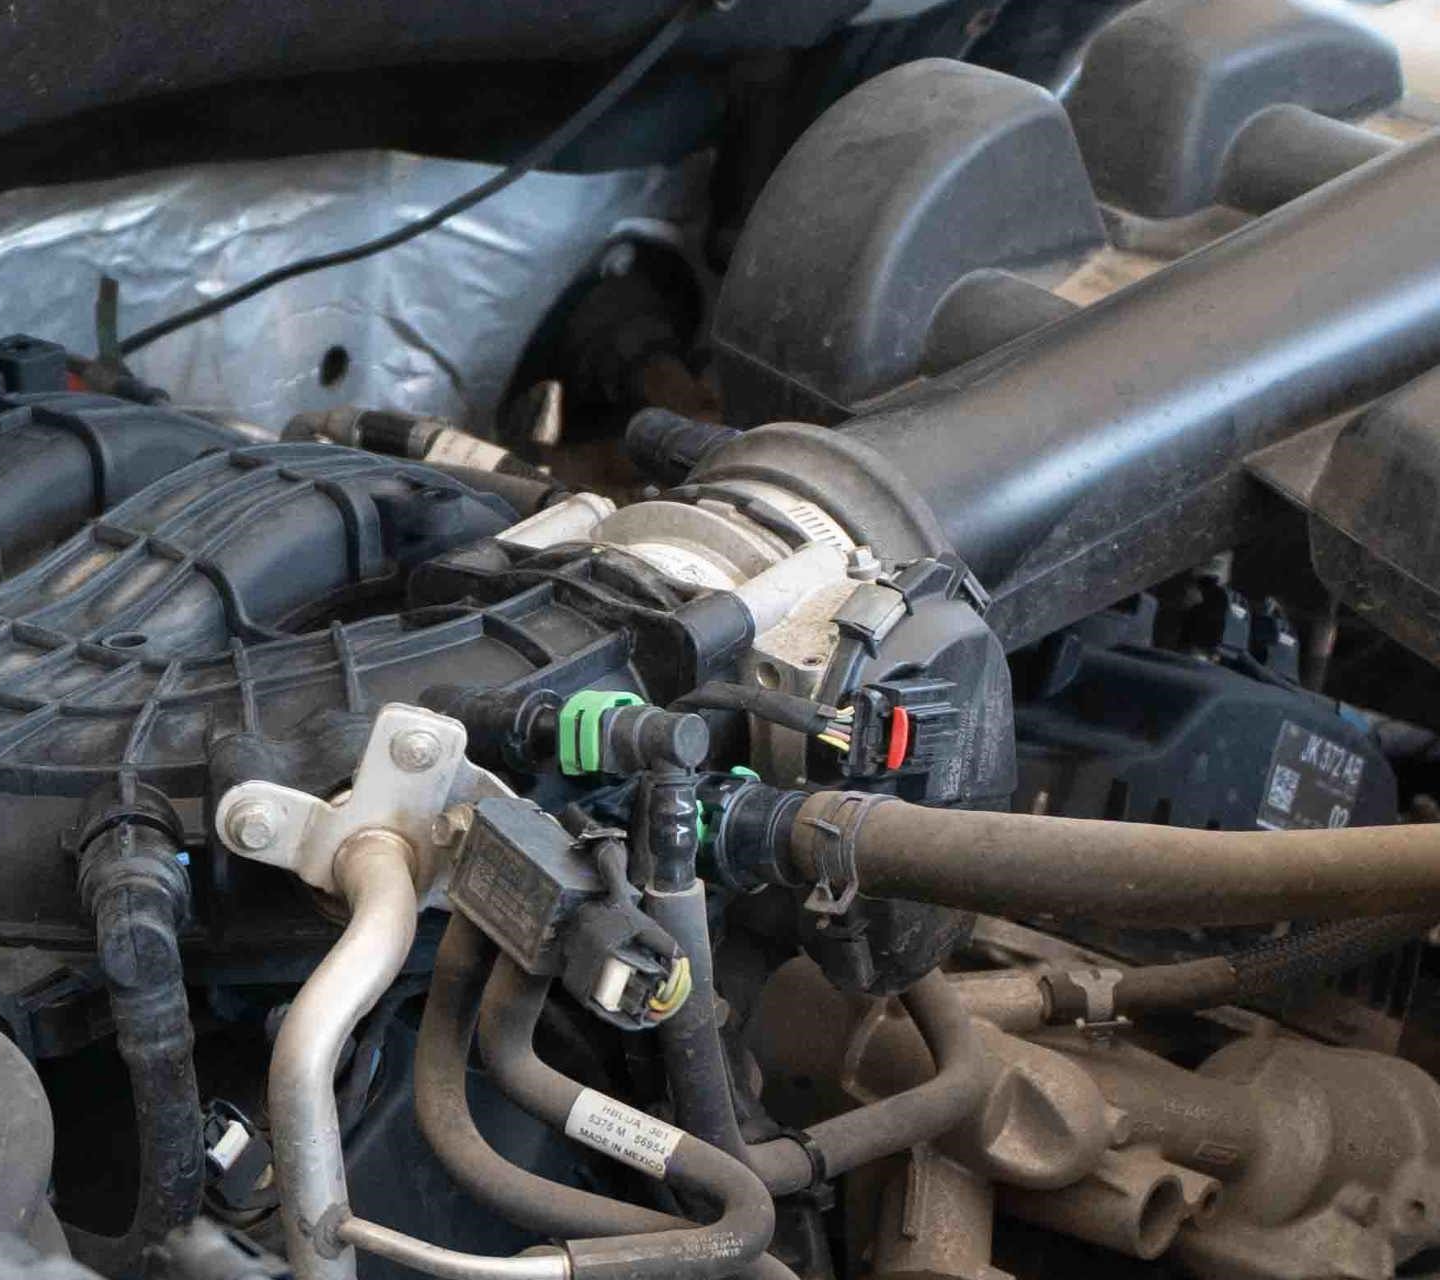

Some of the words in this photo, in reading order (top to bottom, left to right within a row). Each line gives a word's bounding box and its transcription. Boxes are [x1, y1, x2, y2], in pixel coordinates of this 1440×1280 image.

[580, 1127, 609, 1146] MADE
[611, 1142, 622, 1154] IN
[623, 1149, 663, 1173] MEXICO
